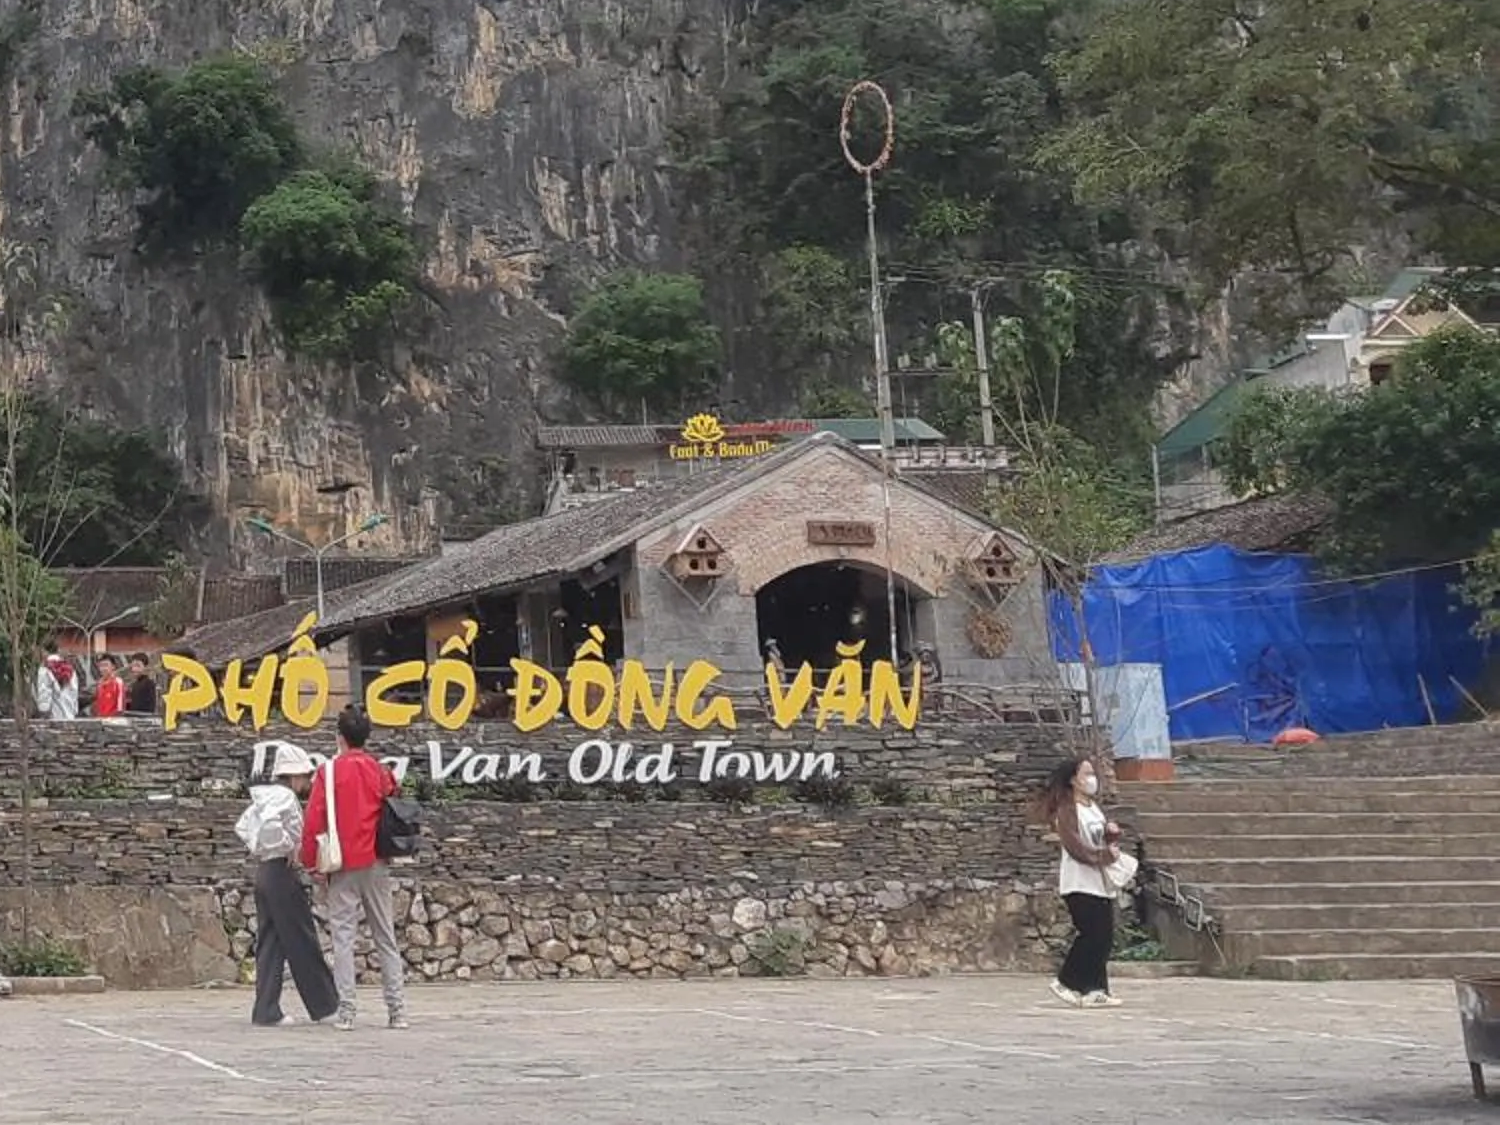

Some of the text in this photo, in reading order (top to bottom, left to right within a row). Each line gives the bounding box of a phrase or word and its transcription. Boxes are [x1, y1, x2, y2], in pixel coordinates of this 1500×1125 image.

[703, 441, 715, 458] &
[161, 610, 922, 732] PHỐ CỔ ĐỒNG VĂN
[426, 739, 547, 784] Van
[568, 738, 679, 785] Old
[692, 739, 842, 784] Town
